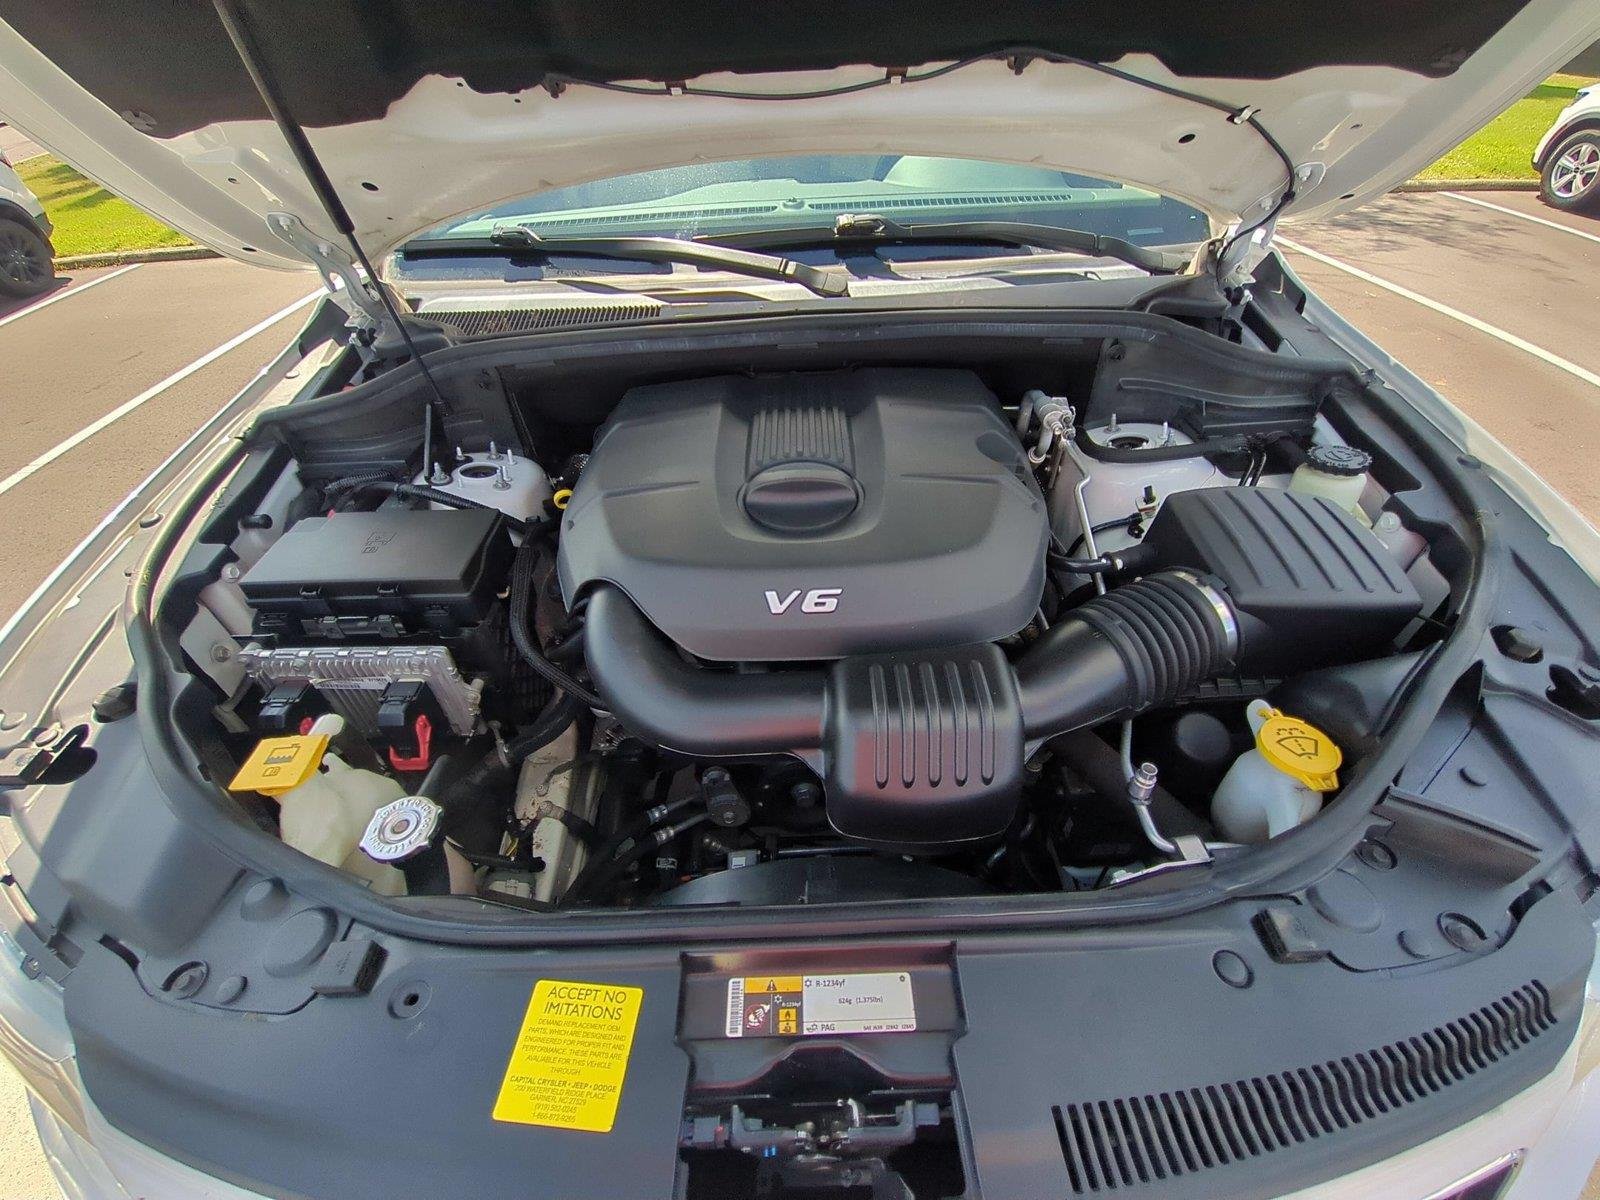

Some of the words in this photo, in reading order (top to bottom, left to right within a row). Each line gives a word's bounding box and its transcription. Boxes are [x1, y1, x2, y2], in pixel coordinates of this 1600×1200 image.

[764, 588, 843, 615] V6
[816, 979, 846, 988] R-1234yf
[548, 986, 600, 1002] ACCEPT
[604, 990, 626, 1004] NO
[544, 1002, 622, 1020] IMITATIONS
[564, 1020, 605, 1030] REPLACEMENT
[582, 1032, 613, 1040] DESIGNED
[525, 1036, 562, 1045] ENGINEERED
[576, 1040, 601, 1048] PROPER
[587, 1061, 612, 1069] VEHICLE
[551, 1067, 581, 1075] THROUGH
[510, 1076, 535, 1085] CAPITAL
[593, 1084, 617, 1093] DODGE
[585, 1091, 607, 1100] PLACE
